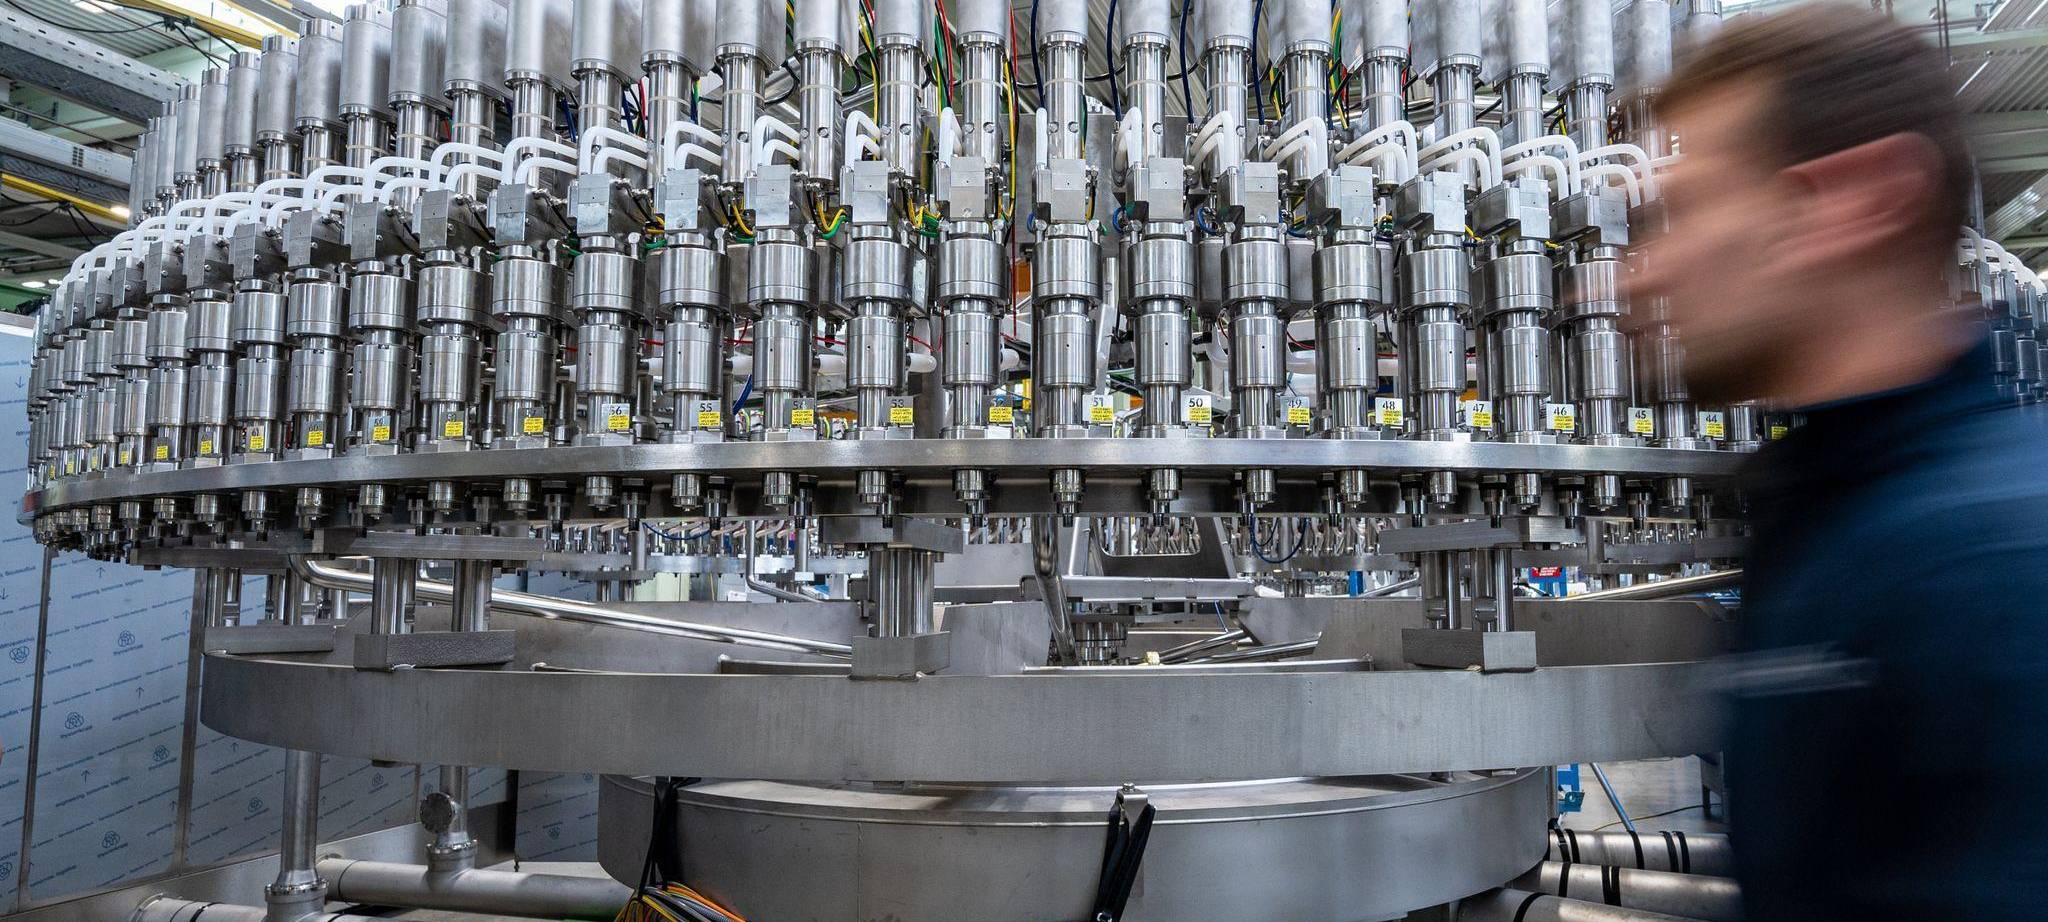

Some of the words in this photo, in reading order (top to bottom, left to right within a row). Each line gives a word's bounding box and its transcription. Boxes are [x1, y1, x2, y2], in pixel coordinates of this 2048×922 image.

[892, 399, 904, 408] 53
[1092, 397, 1104, 407] 51
[1189, 398, 1203, 407] 50
[1288, 399, 1302, 409] 49
[1383, 401, 1395, 410] 48
[609, 406, 622, 415] 56
[699, 403, 713, 412] 55
[1473, 403, 1485, 413] 47
[1554, 407, 1567, 416] 46
[1635, 410, 1647, 419] 45
[1705, 414, 1717, 423] 44
